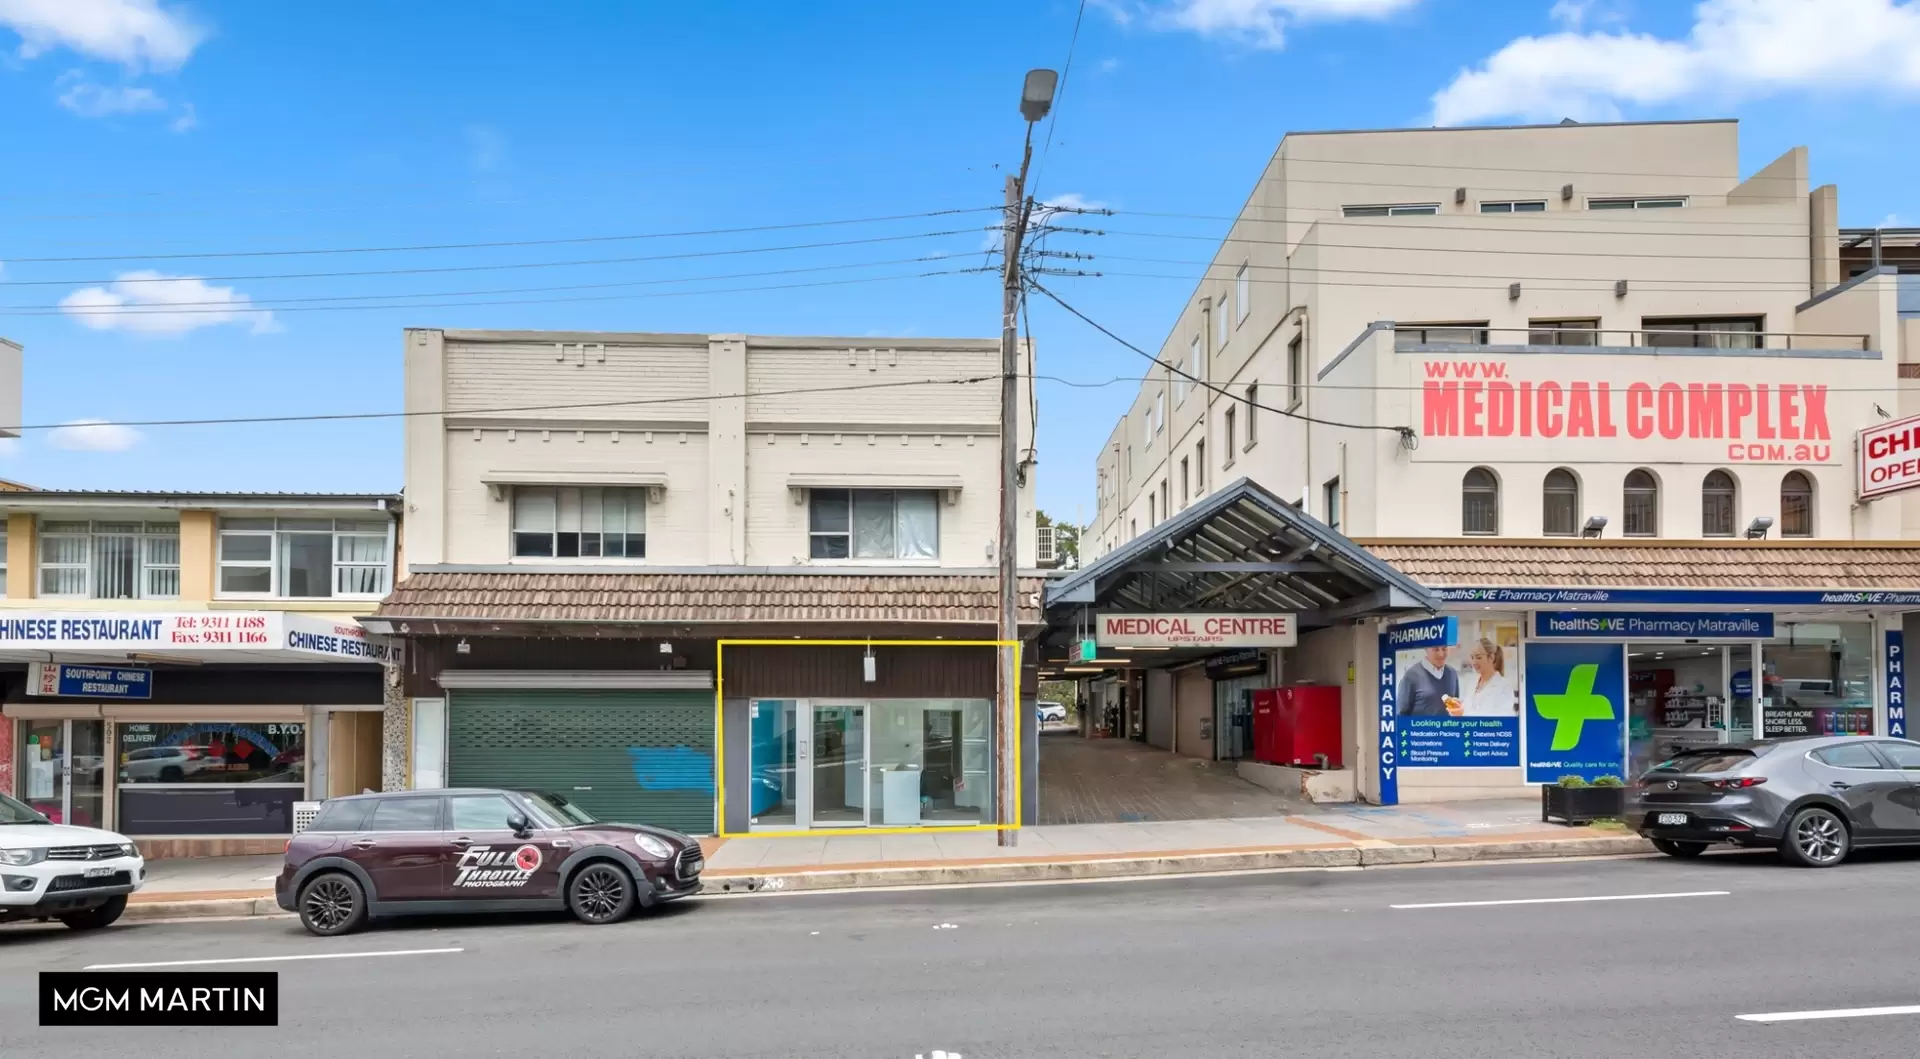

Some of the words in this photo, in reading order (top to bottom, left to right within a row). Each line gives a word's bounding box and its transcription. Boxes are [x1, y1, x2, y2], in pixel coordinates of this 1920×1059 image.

[1423, 381, 1617, 438] MEDICAL
[1626, 382, 1831, 440] COMPLEX
[1498, 589, 1554, 602] Pharmacy
[1556, 590, 1609, 601] Matraville
[176, 616, 197, 629] Tel:
[201, 616, 230, 629] 9311
[236, 616, 265, 629] 1188
[1106, 618, 1195, 636] MEDICAL
[1204, 618, 1287, 636] CENTRE
[1629, 618, 1695, 634] Pharmacy
[1698, 619, 1760, 632] Matraville
[61, 619, 162, 640] RESTAURANT
[1389, 624, 1446, 645] PHARMACY
[172, 631, 200, 643] Fax:
[204, 631, 233, 643] 9311
[239, 631, 268, 643] 1166
[288, 631, 339, 653] CHINESE
[341, 638, 402, 662] RESTAURANT
[65, 667, 113, 681] SOUTHPOINT
[117, 671, 145, 682] CHINESE
[82, 682, 129, 694] RESTAURANT
[1381, 657, 1395, 780] PHARMACY
[1411, 719, 1441, 728] Looking
[1461, 721, 1478, 729] your
[1480, 719, 1503, 727] health
[1765, 718, 1787, 726] SNORE
[1788, 718, 1804, 726] LESS.
[129, 724, 151, 732] HOME
[123, 734, 157, 743] DELIVERY
[1473, 750, 1490, 758] Expert
[1563, 761, 1583, 769] Quality
[453, 865, 534, 886] THROTTLE
[462, 880, 528, 888] PHOTOGRAPHY
